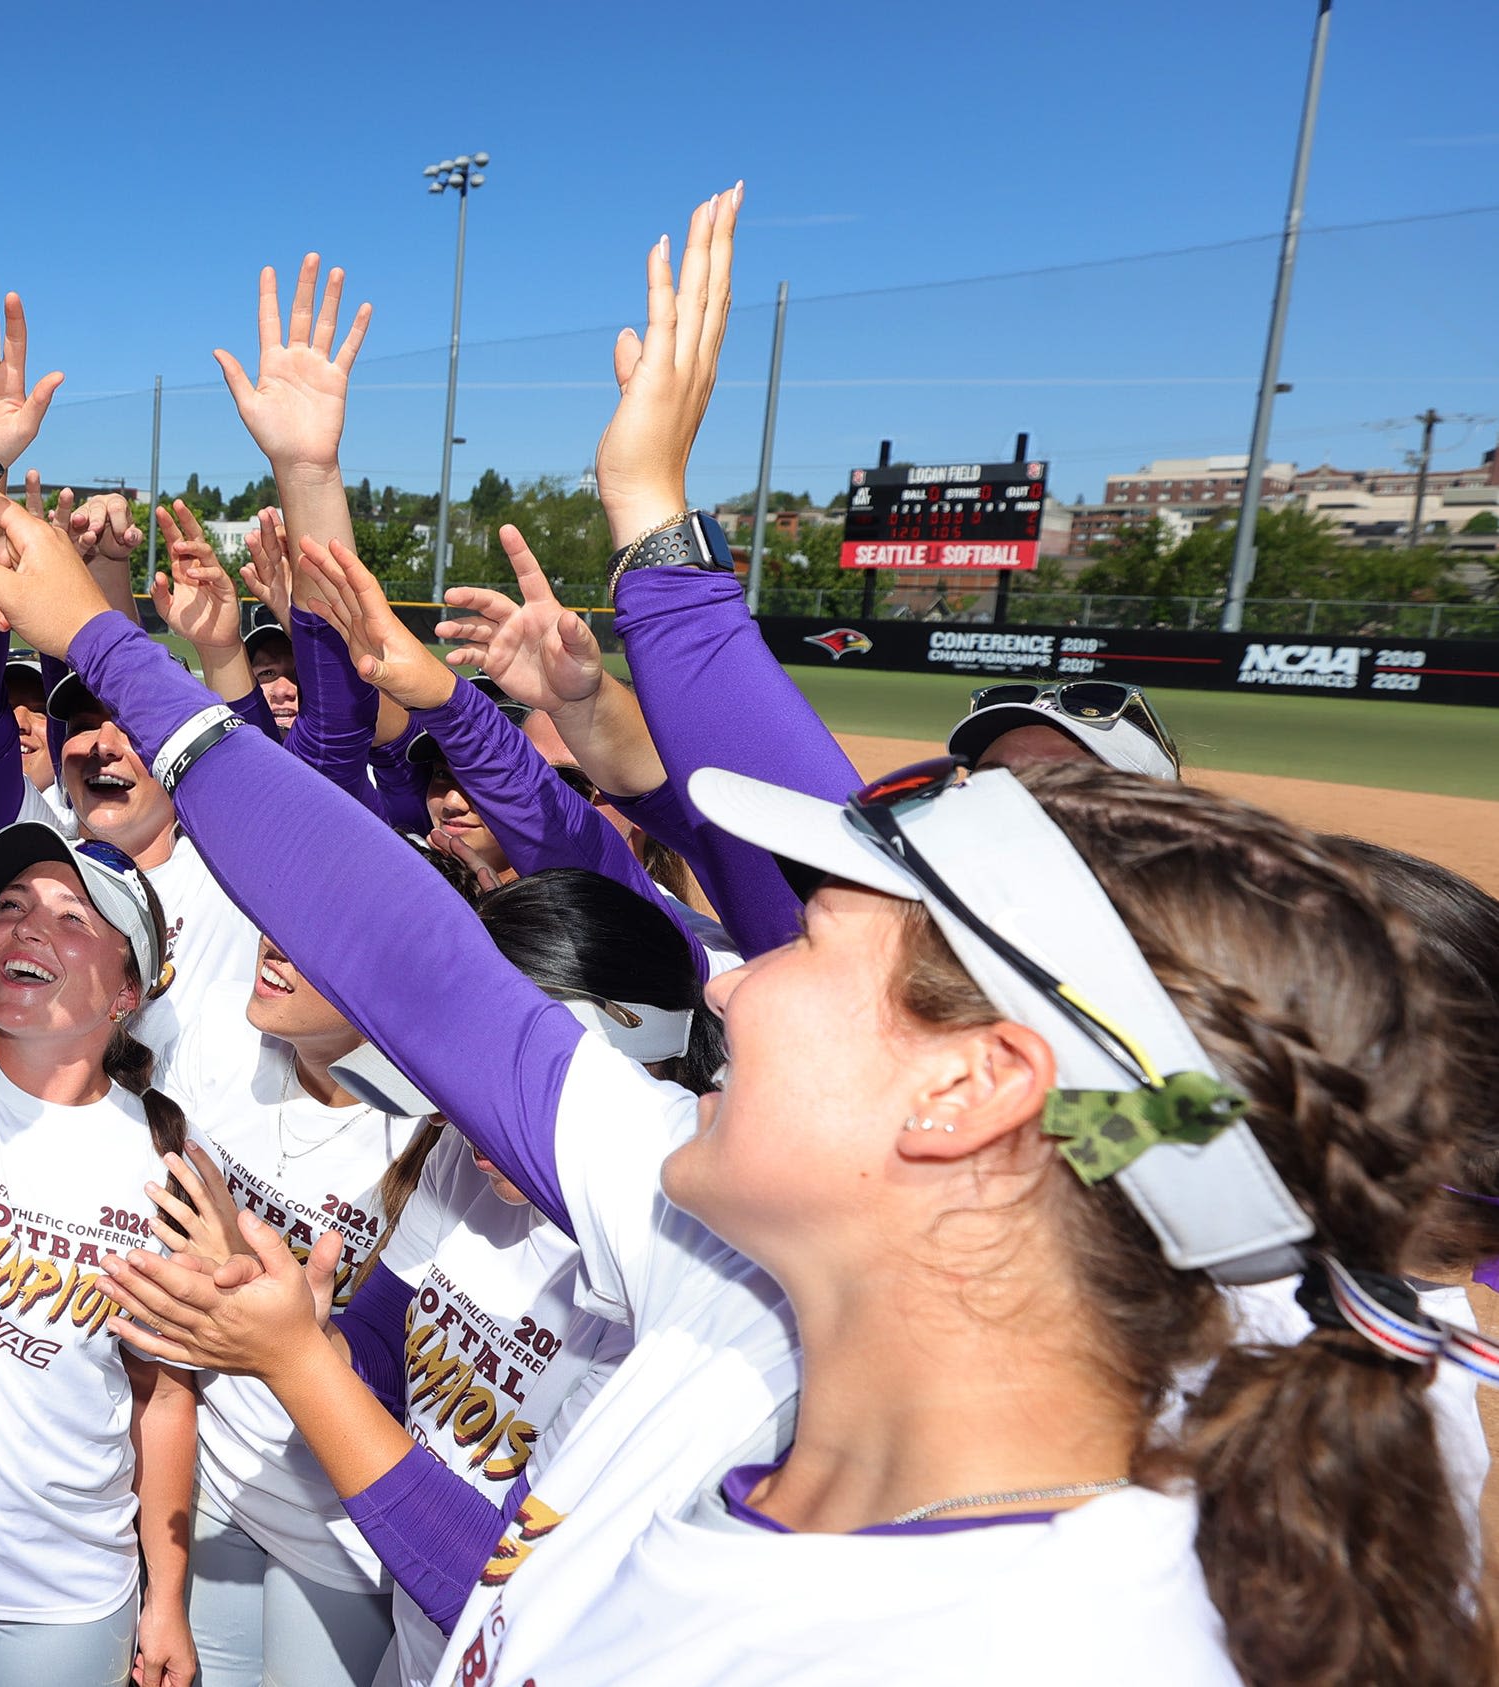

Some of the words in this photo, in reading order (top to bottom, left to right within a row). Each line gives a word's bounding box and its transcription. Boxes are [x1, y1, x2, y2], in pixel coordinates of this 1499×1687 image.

[907, 466, 947, 484] LOGAN
[947, 464, 982, 482] FIELD
[945, 487, 981, 500] STRIKE
[855, 545, 928, 565] SEATTLE
[941, 545, 1020, 565] SOFTBALL
[930, 631, 1055, 653] CONFERENCE
[1061, 637, 1098, 652] 2019
[927, 650, 1052, 667] CHAMPIONSHIPS
[1058, 657, 1095, 672] 2021
[1239, 644, 1360, 675] NCAA
[1237, 670, 1357, 688] APPEARANCES
[233, 1163, 284, 1202] ATHLETIC
[321, 1193, 379, 1238] 2024
[67, 1222, 147, 1250] CONFERENCE
[453, 1291, 501, 1339] ATHLETIC
